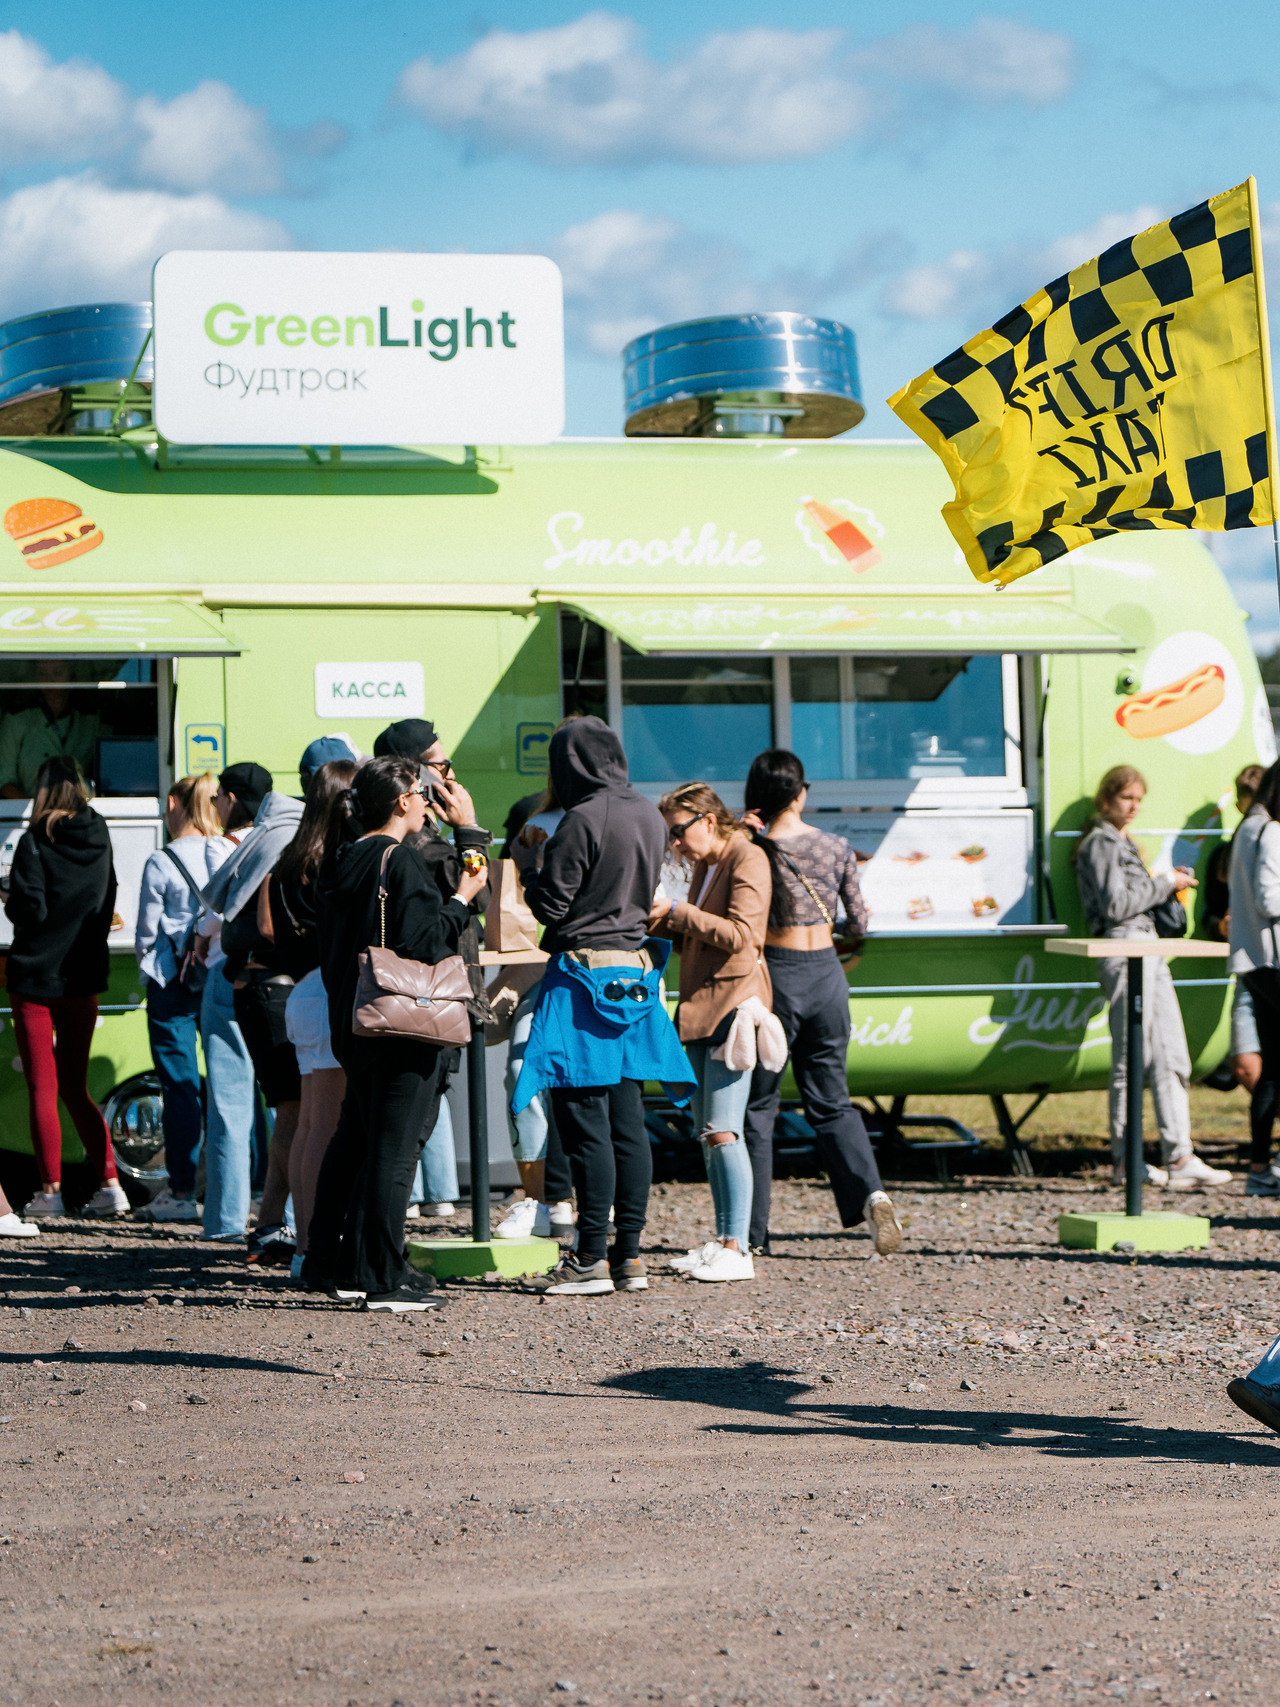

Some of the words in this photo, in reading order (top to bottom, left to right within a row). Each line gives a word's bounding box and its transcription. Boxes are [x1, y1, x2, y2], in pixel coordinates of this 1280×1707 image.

[204, 299, 517, 361] GreenLight
[203, 360, 368, 399] Фудтрак
[543, 511, 766, 571] Smoothie
[332, 682, 407, 698] КАССА
